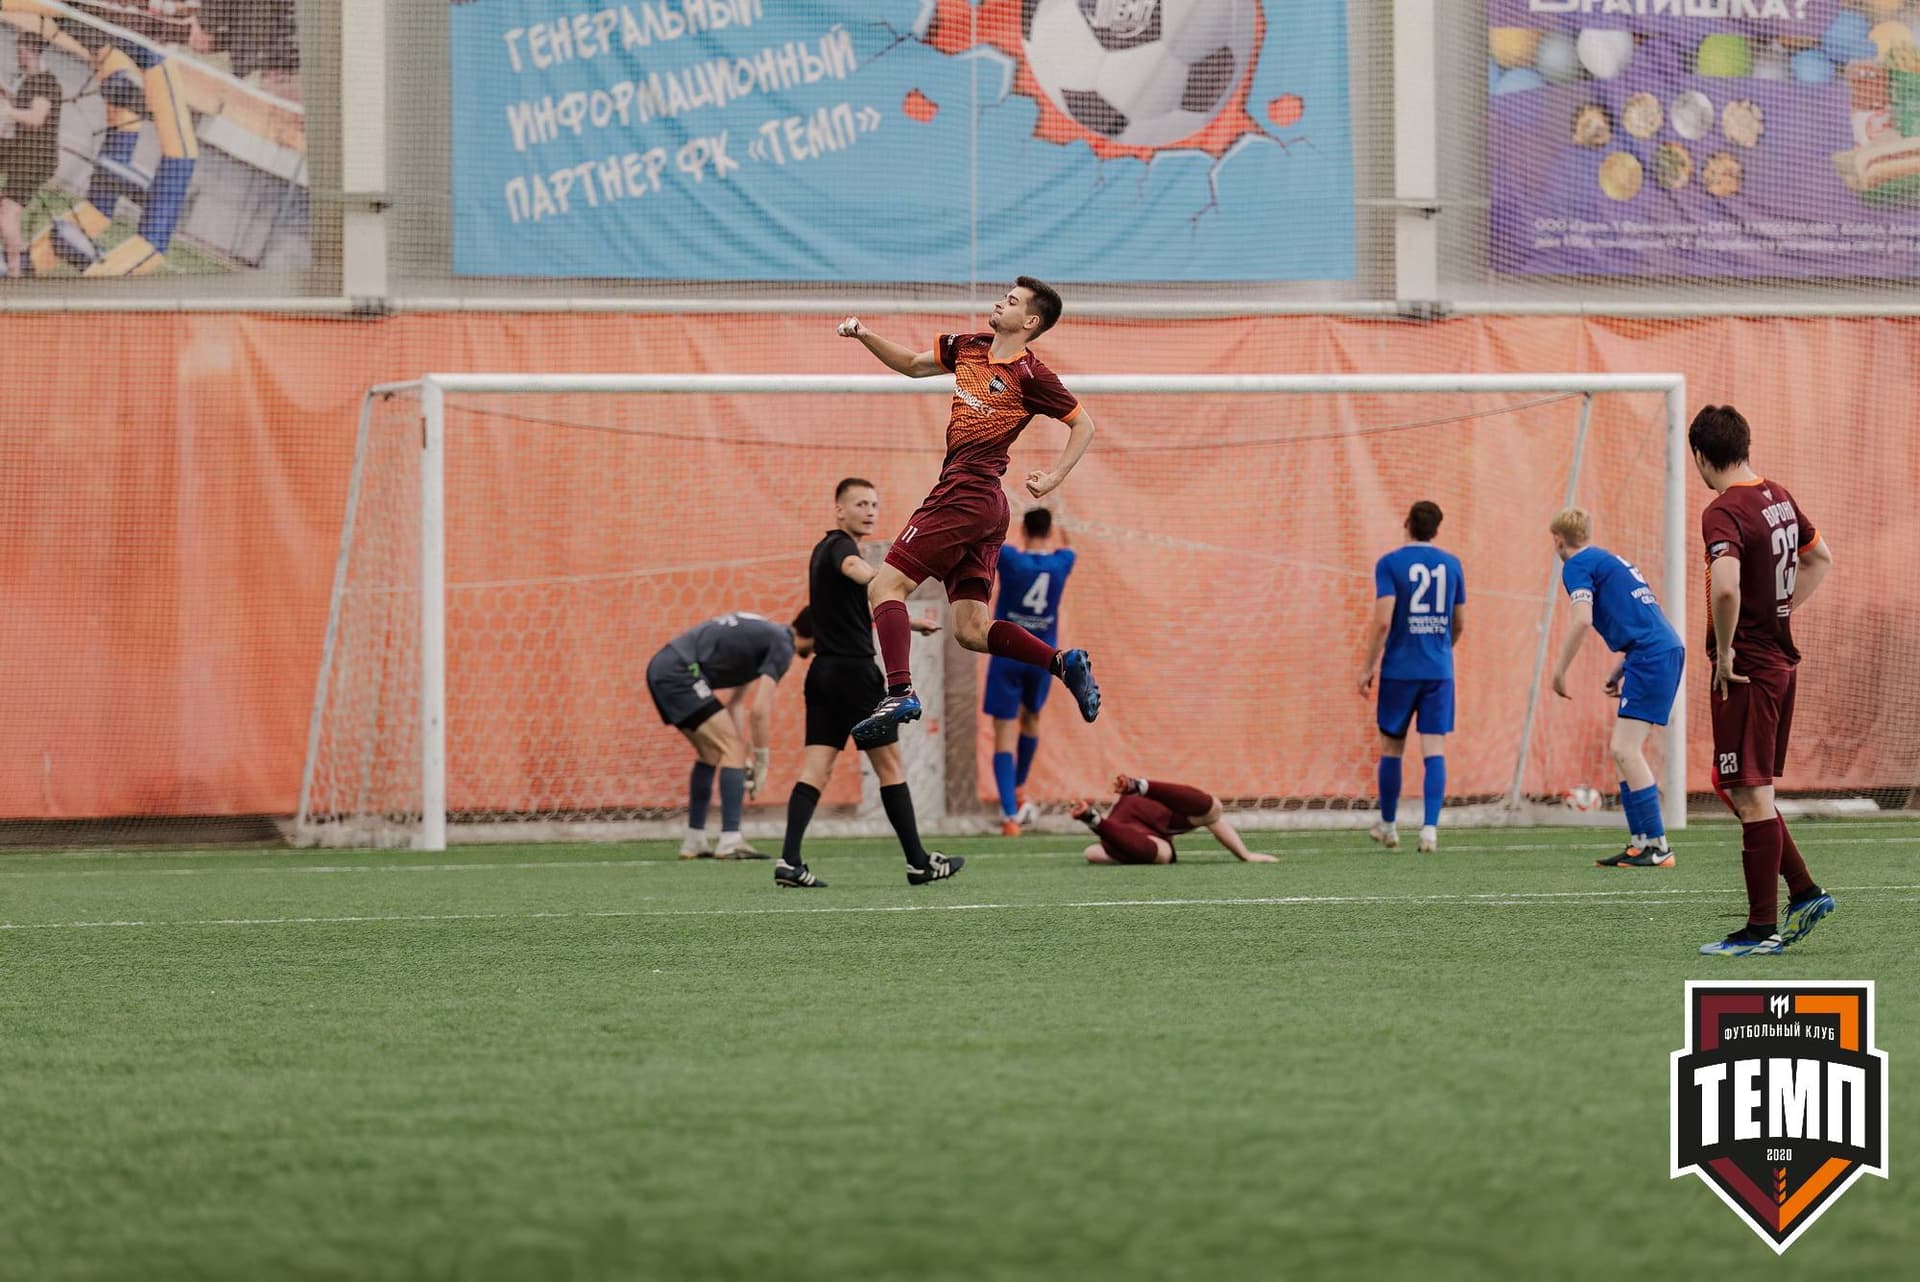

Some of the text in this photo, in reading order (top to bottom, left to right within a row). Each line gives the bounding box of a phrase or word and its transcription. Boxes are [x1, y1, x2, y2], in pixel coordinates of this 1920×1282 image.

[506, 24, 857, 151] ИНФОРМАЦИОННЫЙ
[505, 103, 881, 223] ПАРТНЕР ФК «ТЕМП»
[901, 525, 918, 543] 11
[1771, 523, 1799, 600] 23
[1022, 571, 1050, 614] 4
[1409, 563, 1446, 613] 21
[1720, 752, 1738, 774] 23
